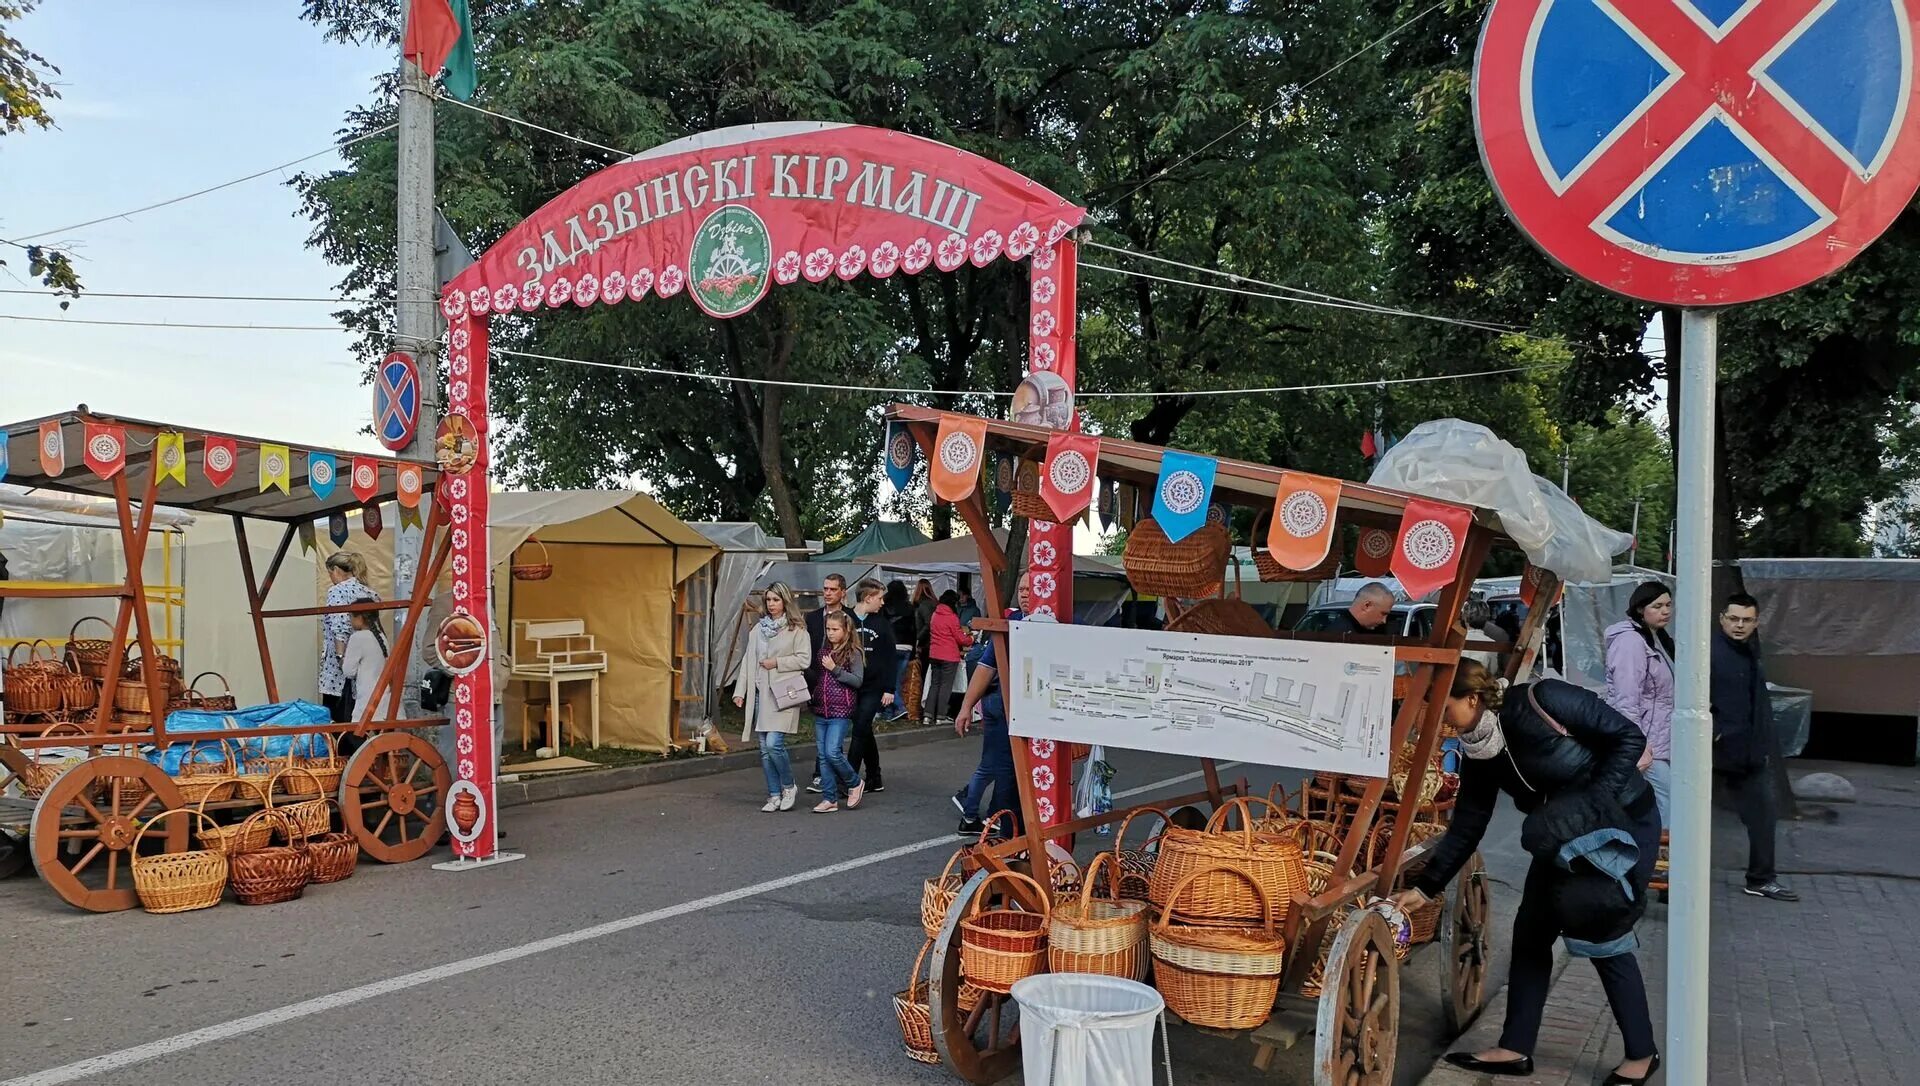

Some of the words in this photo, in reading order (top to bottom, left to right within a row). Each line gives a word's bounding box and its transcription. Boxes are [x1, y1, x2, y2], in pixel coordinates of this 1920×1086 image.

[516, 154, 756, 290] ЗАДЗВІНСКІ
[769, 154, 981, 236] КІРМАШ
[1162, 652, 1185, 661] Ярмарка
